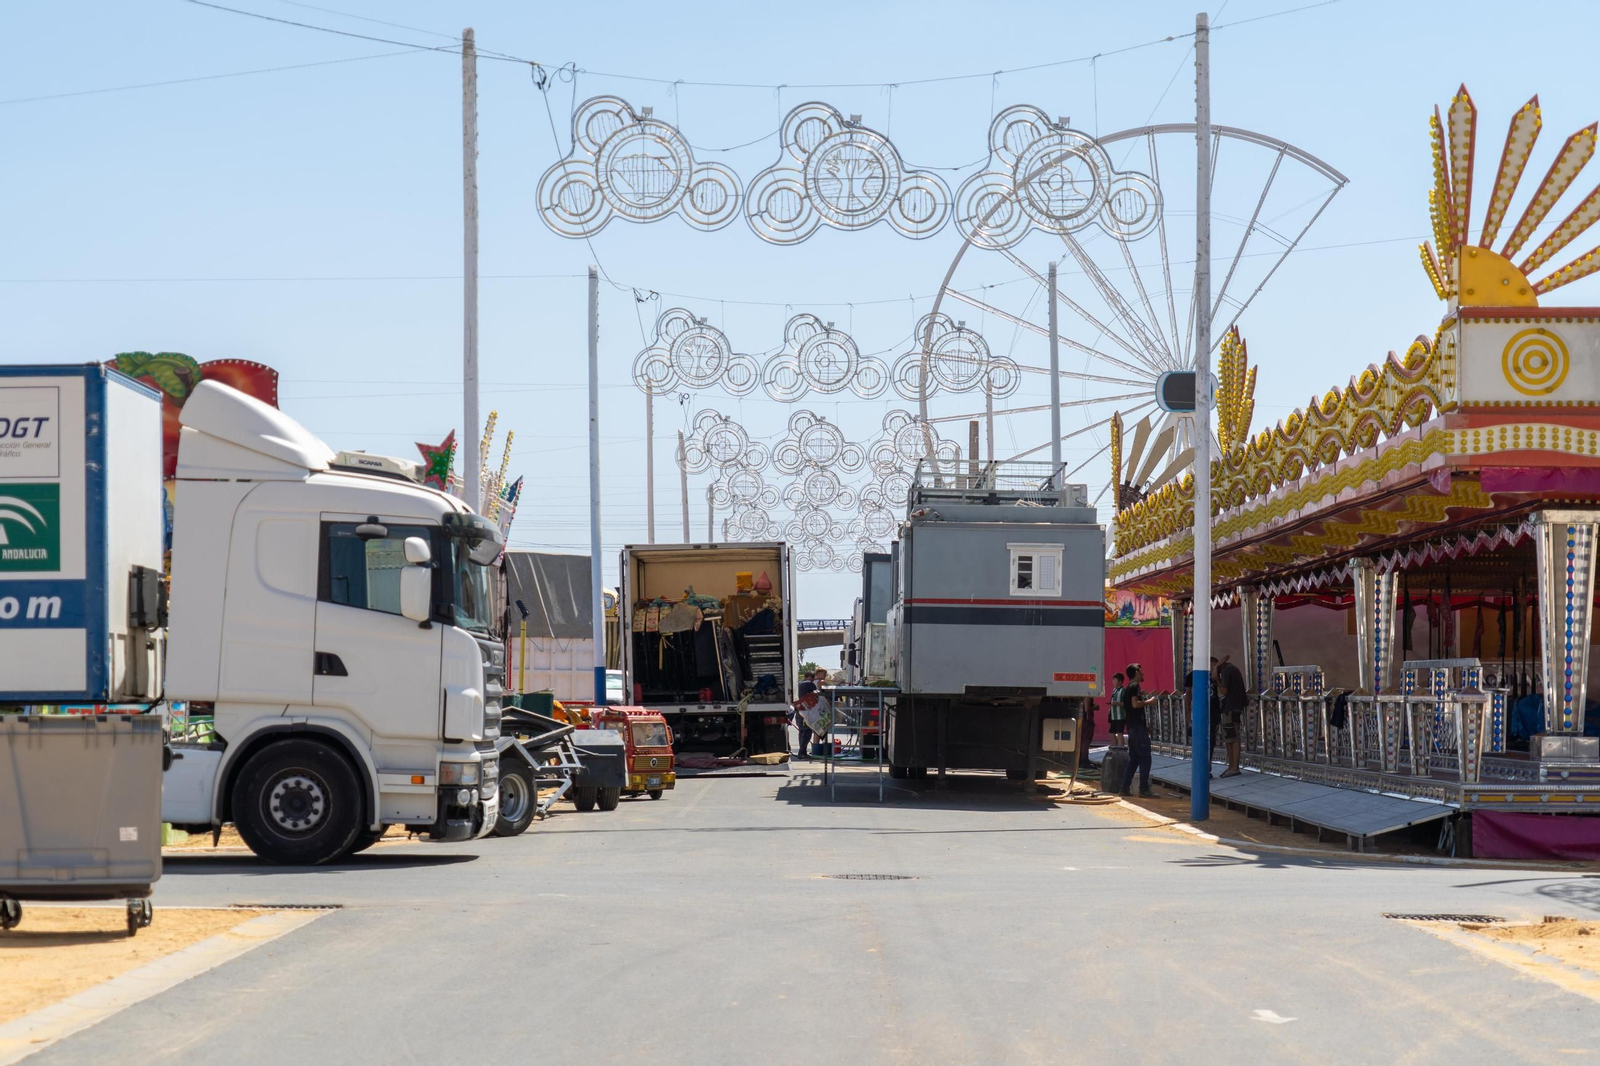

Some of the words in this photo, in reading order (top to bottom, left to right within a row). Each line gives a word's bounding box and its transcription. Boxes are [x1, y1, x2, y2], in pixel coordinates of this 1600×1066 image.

[0, 441, 20, 449] cción
[22, 441, 51, 449] General
[358, 459, 382, 467] SCANIA
[2, 549, 47, 560] ANDALUCIA
